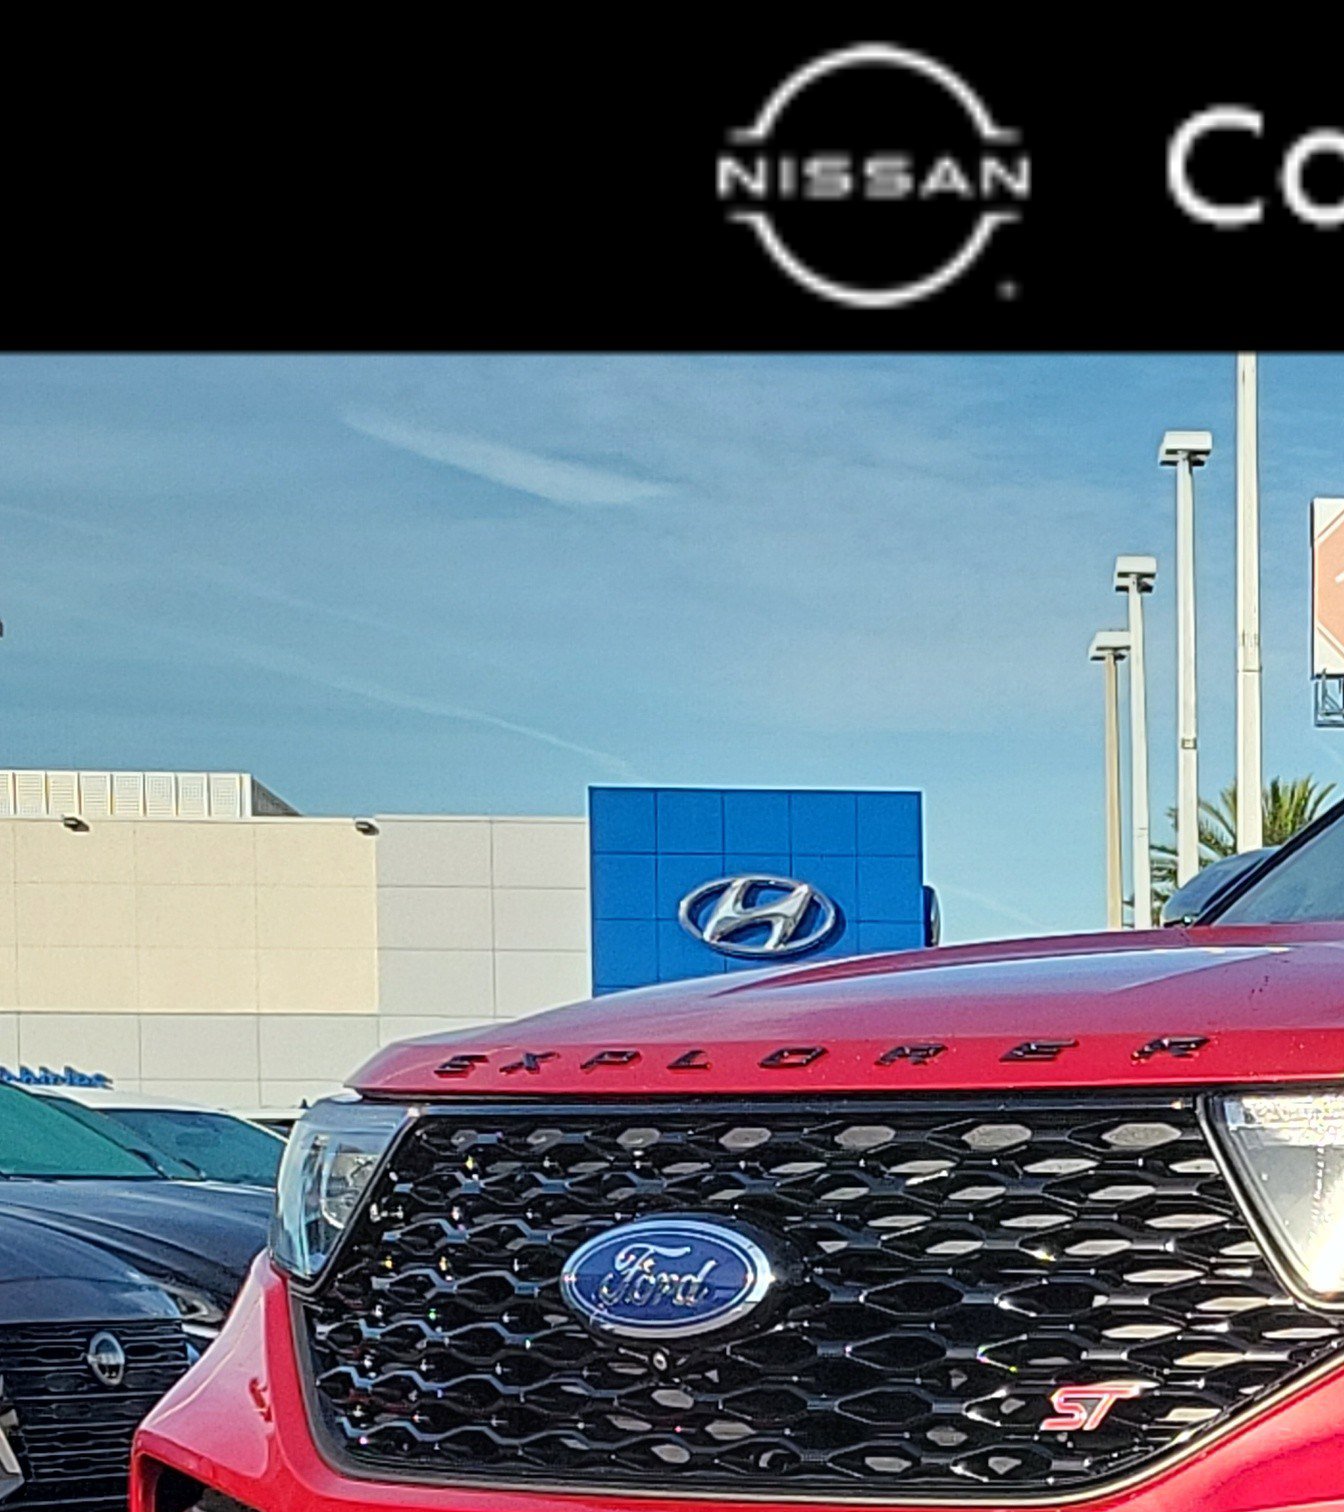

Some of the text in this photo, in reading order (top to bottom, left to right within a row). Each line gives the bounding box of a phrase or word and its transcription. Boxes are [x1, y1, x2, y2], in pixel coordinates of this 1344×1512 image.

[432, 1035, 1213, 1079] EXPLORER
[599, 1242, 718, 1307] Ford
[1039, 1380, 1160, 1431] ST
